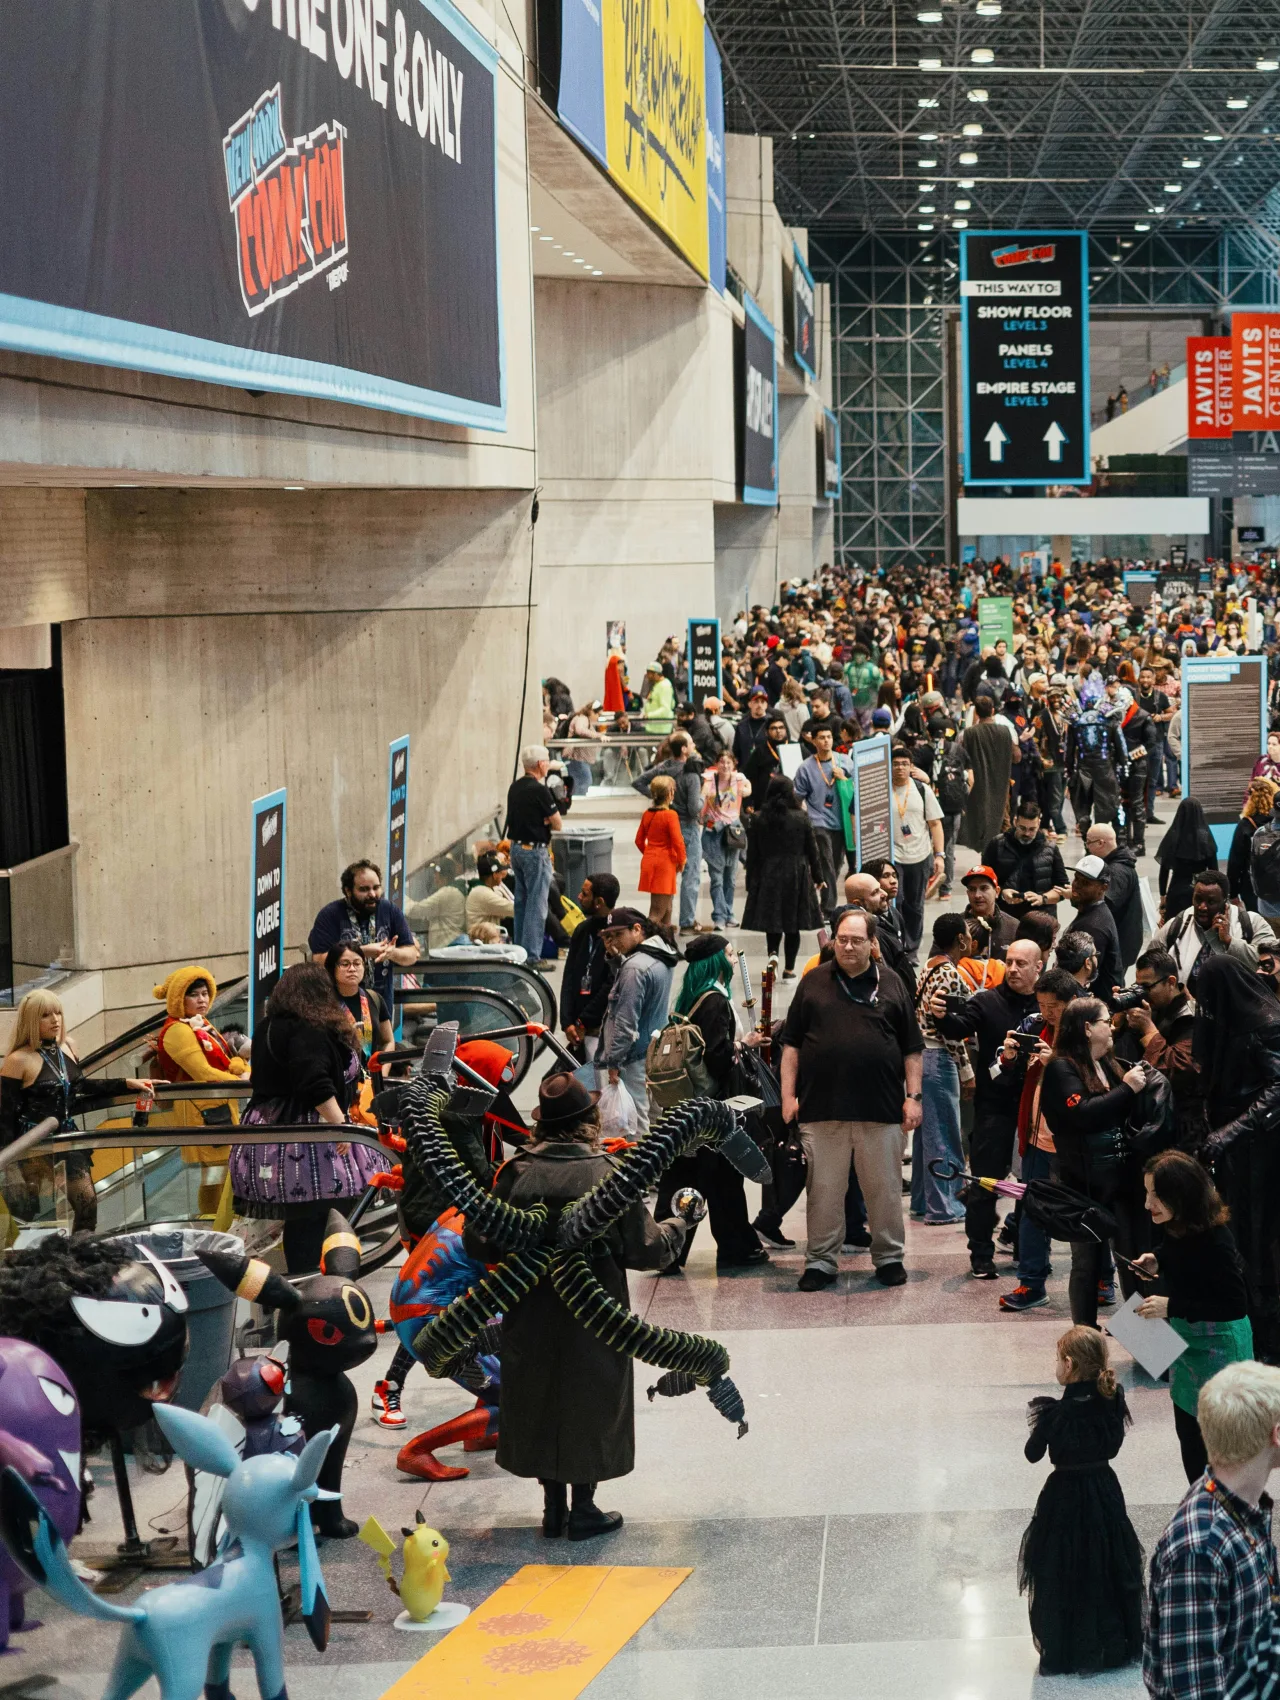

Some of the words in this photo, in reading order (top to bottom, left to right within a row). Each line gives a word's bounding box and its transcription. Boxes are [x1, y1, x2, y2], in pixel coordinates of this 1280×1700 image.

[394, 9, 412, 127] &
[412, 30, 464, 164] ONLY
[976, 284, 1005, 293] THIS
[1008, 284, 1035, 293] WAY
[1037, 284, 1058, 293] TO:
[977, 306, 1022, 318] SHOW
[1024, 306, 1072, 318] FLOOR
[1004, 321, 1039, 331] LEVEL
[1040, 321, 1047, 331] 3
[998, 344, 1053, 356] PANELS
[1004, 359, 1039, 369] LEVEL
[1040, 359, 1048, 369] 4
[1242, 328, 1262, 414] JAVITS
[977, 382, 1029, 394] EMPIRE
[1031, 382, 1076, 394] STAGE
[1195, 350, 1213, 425] JAVITS
[1219, 349, 1233, 426] CENTER
[1005, 397, 1040, 407] LEVEL
[1041, 397, 1048, 407] 5
[1249, 432, 1280, 453] 1A
[697, 646, 704, 655] UP
[705, 646, 712, 655] TO
[694, 659, 715, 671] SHOW
[694, 675, 717, 687] FLOOR
[257, 871, 273, 896] DOWN
[273, 867, 280, 887] TO
[256, 901, 280, 939] QUEUE
[259, 945, 276, 980] HALL
